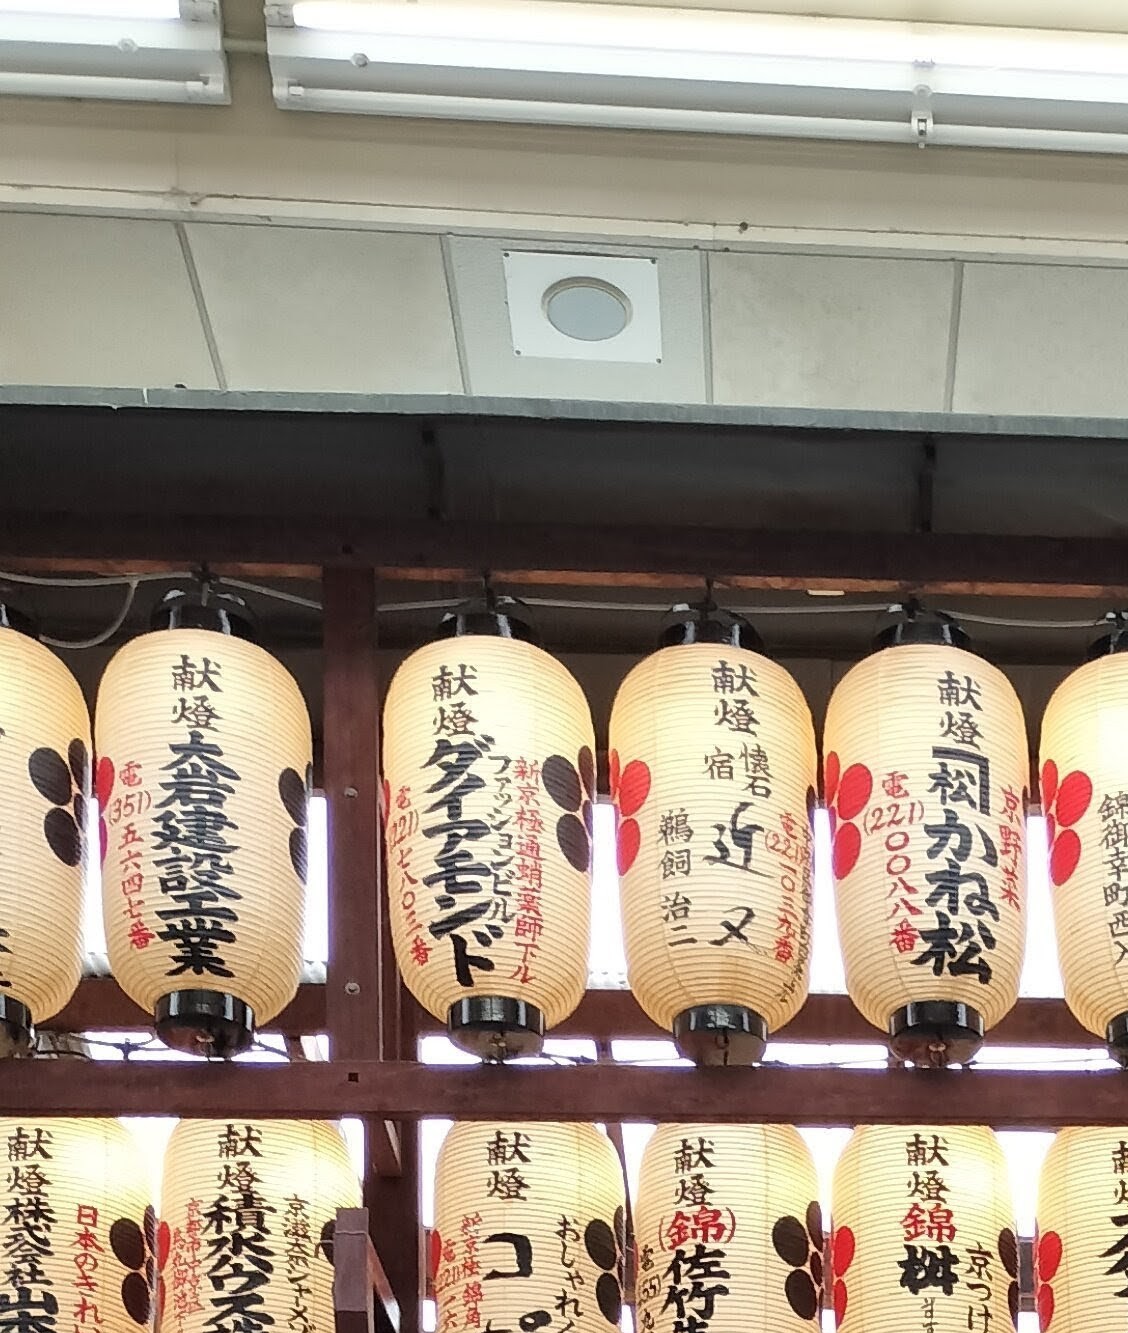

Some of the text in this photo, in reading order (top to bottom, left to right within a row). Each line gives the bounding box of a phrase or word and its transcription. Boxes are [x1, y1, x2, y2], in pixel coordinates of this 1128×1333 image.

[172, 654, 223, 732] 献燈
[433, 664, 479, 736] 献燈
[711, 660, 760, 737] 献燈
[938, 671, 983, 749] 献燈
[704, 742, 774, 799] 懐石 宿
[151, 731, 243, 978] 大岩建設工業
[420, 734, 504, 987] ダイアモンド
[487, 754, 516, 923] ファッションビル
[703, 802, 776, 950] 近又
[911, 809, 999, 985] かね松
[6, 1127, 54, 1198] 献燈
[216, 1124, 264, 1195] 献燈
[486, 1131, 532, 1201] 献燈
[674, 1138, 716, 1207] 献燈
[906, 1133, 950, 1204] 献燈
[900, 1203, 957, 1243] 錦
